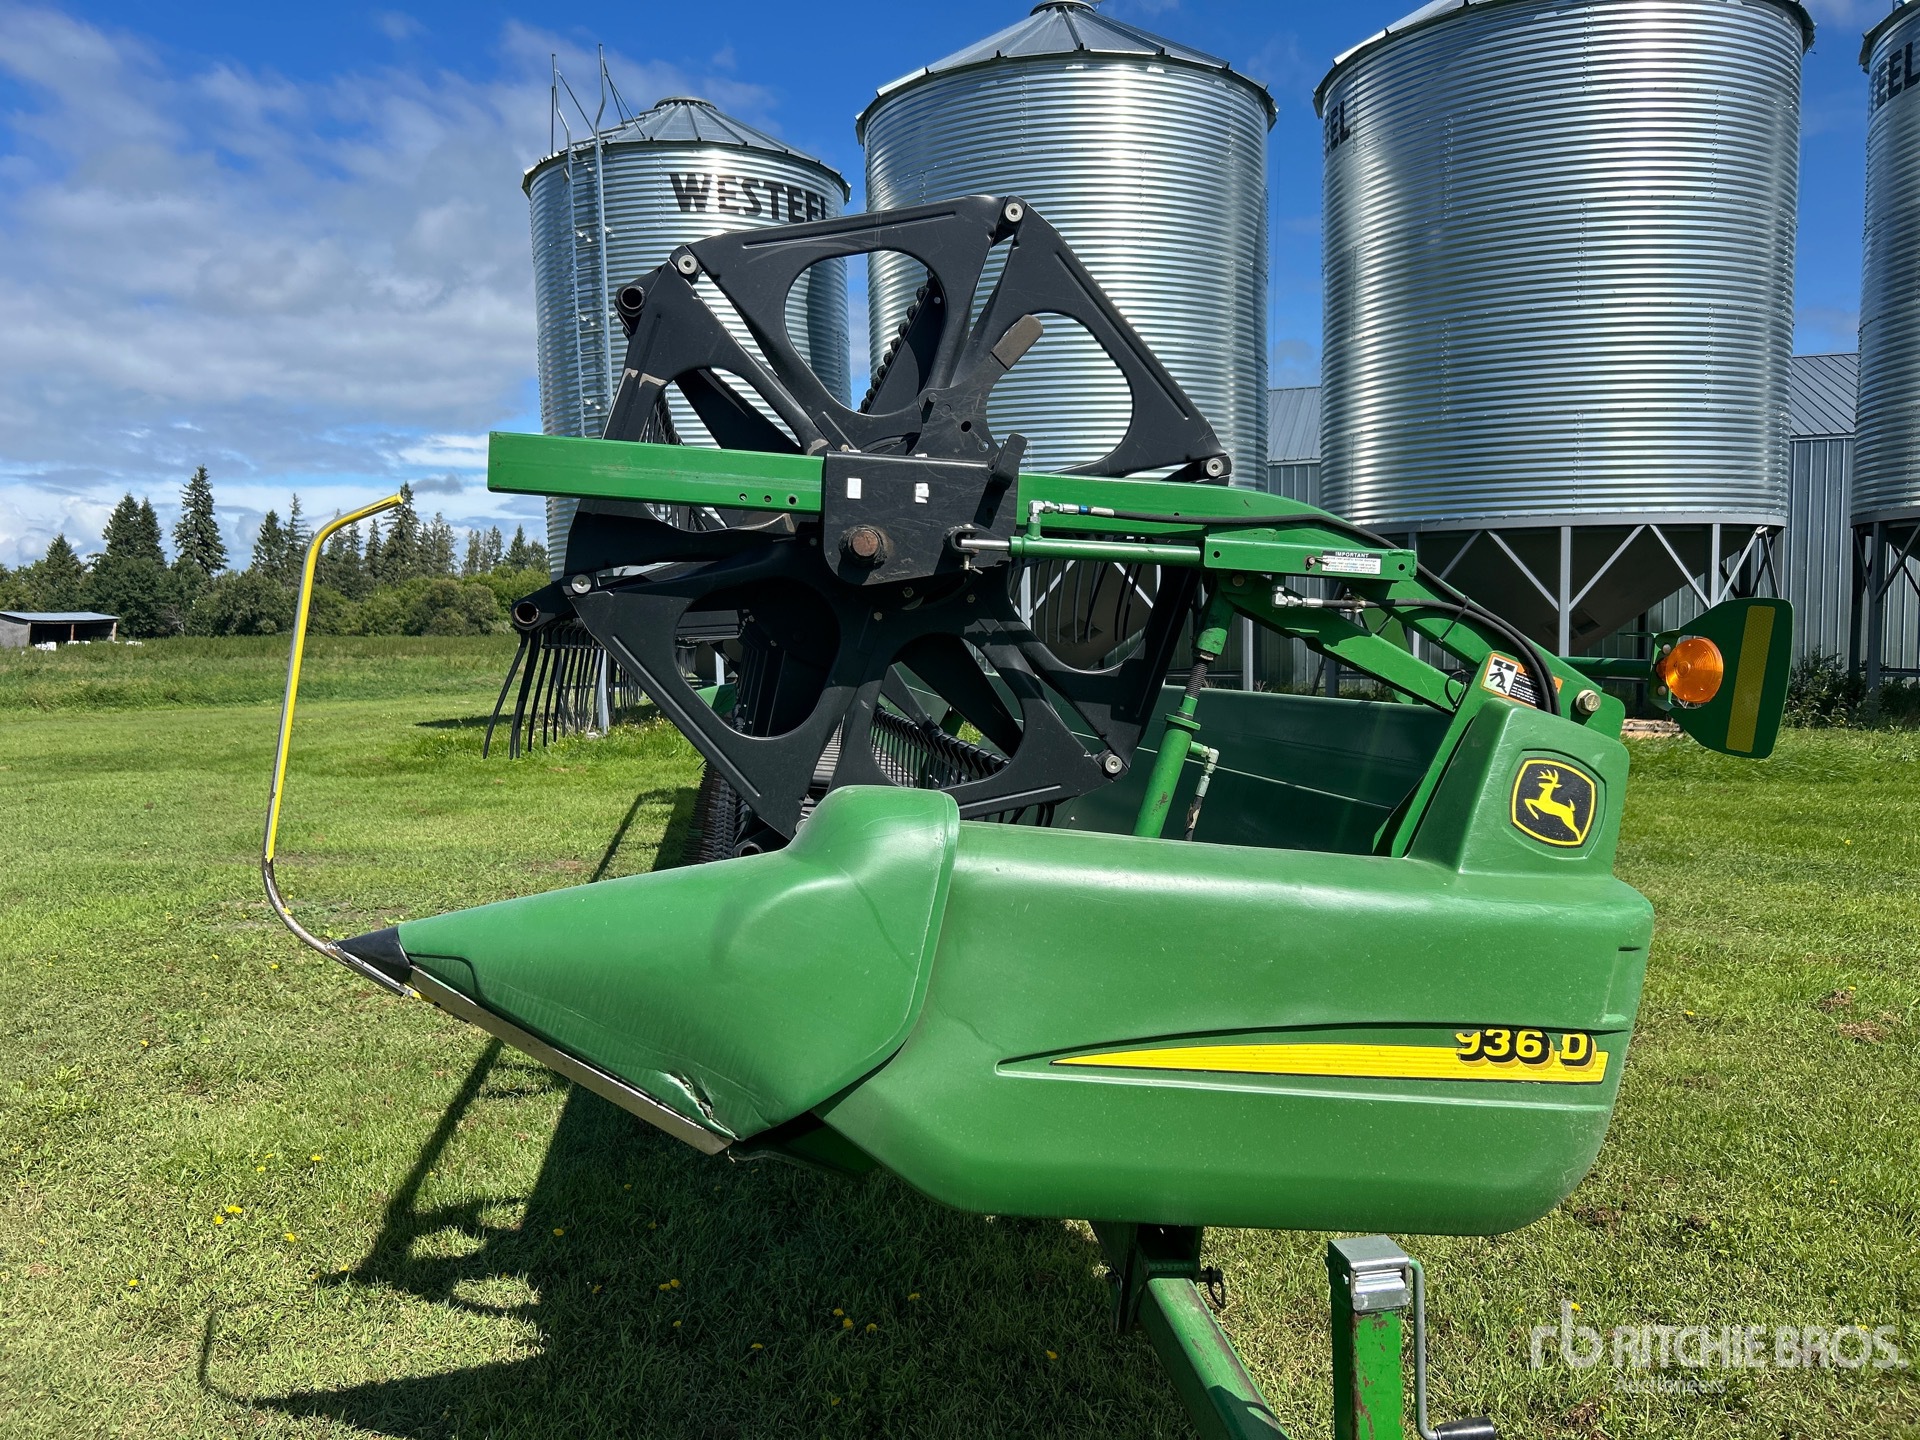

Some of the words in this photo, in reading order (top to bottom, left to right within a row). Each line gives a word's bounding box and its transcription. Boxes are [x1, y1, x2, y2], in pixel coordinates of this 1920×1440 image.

[1335, 551, 1370, 559] IMPORTANT
[1455, 1029, 1552, 1067] 936
[1560, 1032, 1595, 1068] D
